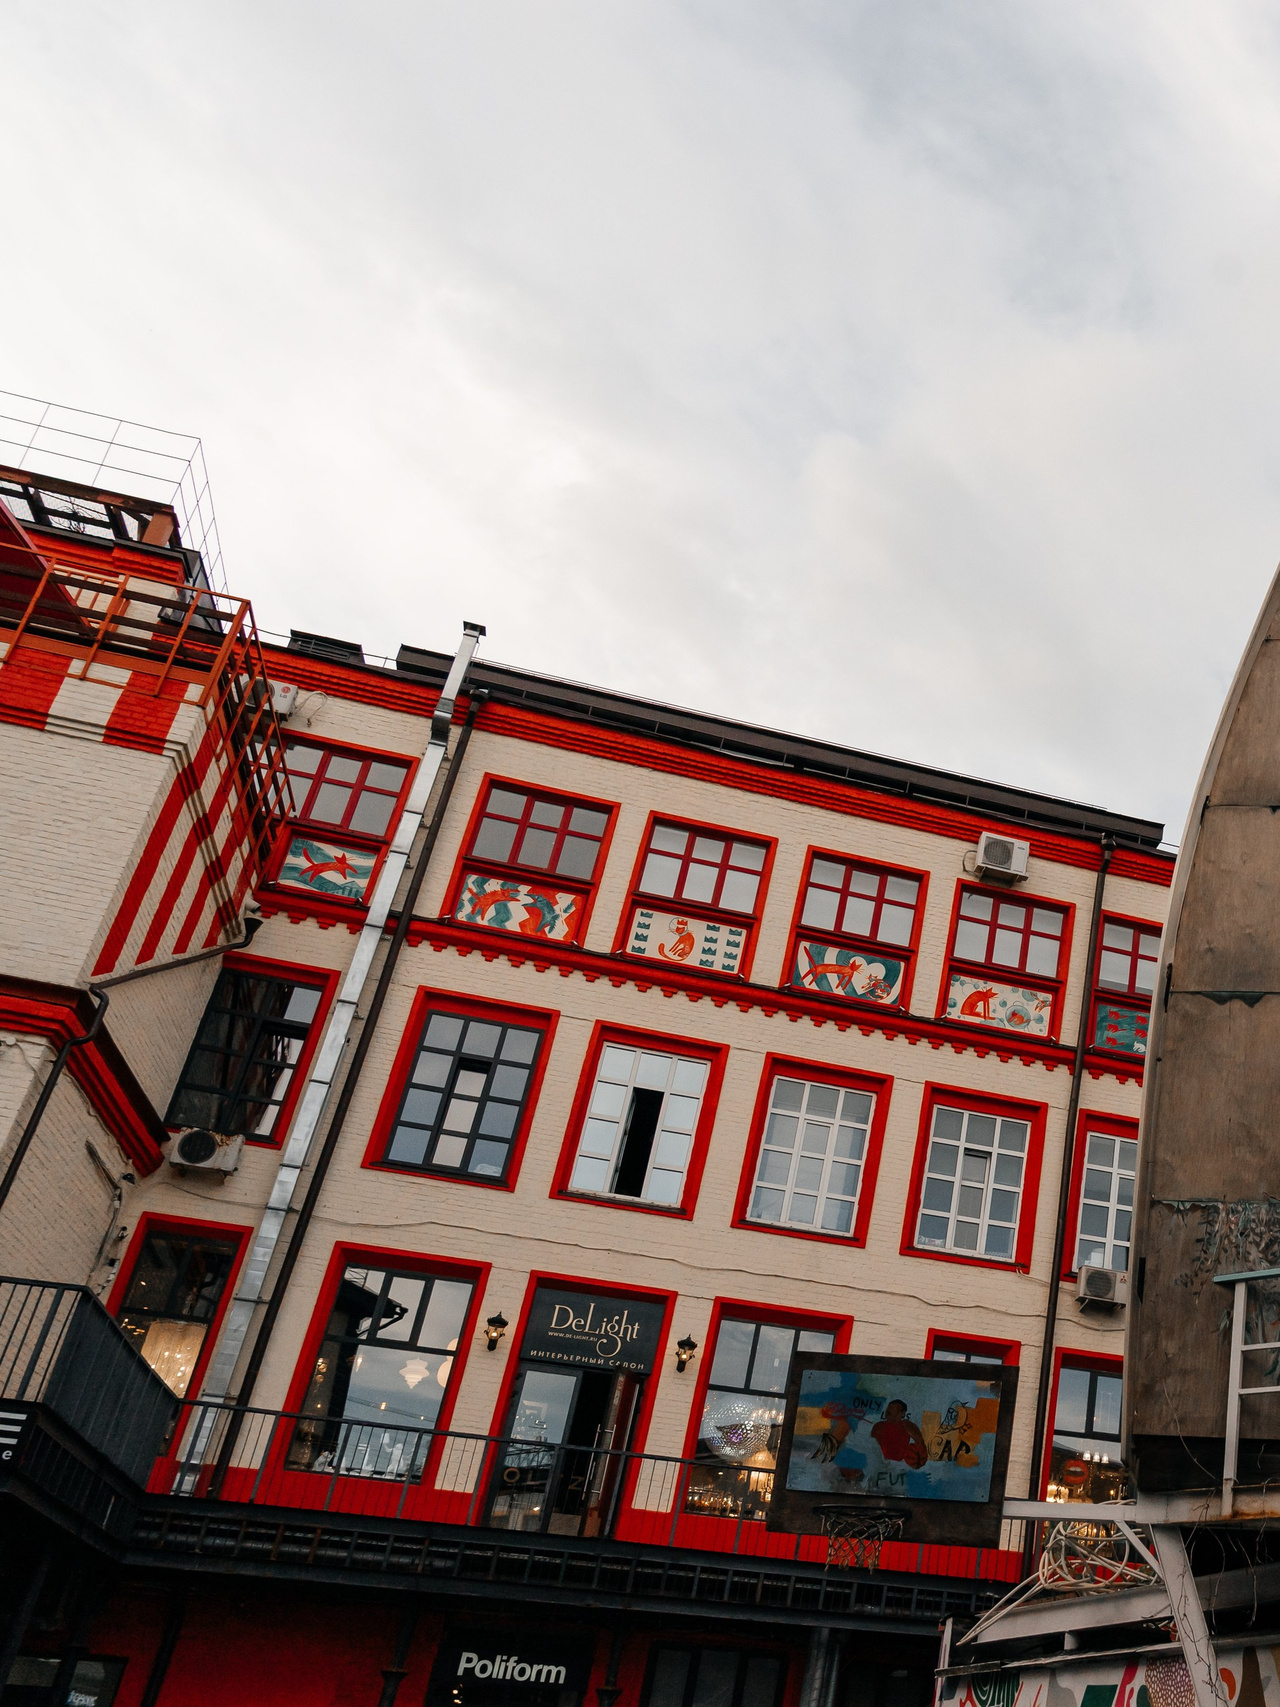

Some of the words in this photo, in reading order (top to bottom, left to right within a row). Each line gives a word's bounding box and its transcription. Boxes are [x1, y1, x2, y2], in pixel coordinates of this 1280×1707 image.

[550, 1302, 640, 1357] DeLight
[530, 1350, 605, 1365] ИНТЕРЬЕРНЫЙ
[608, 1359, 645, 1370] САЛОН
[852, 1397, 882, 1412] ONLY
[457, 1651, 567, 1684] Poliform
